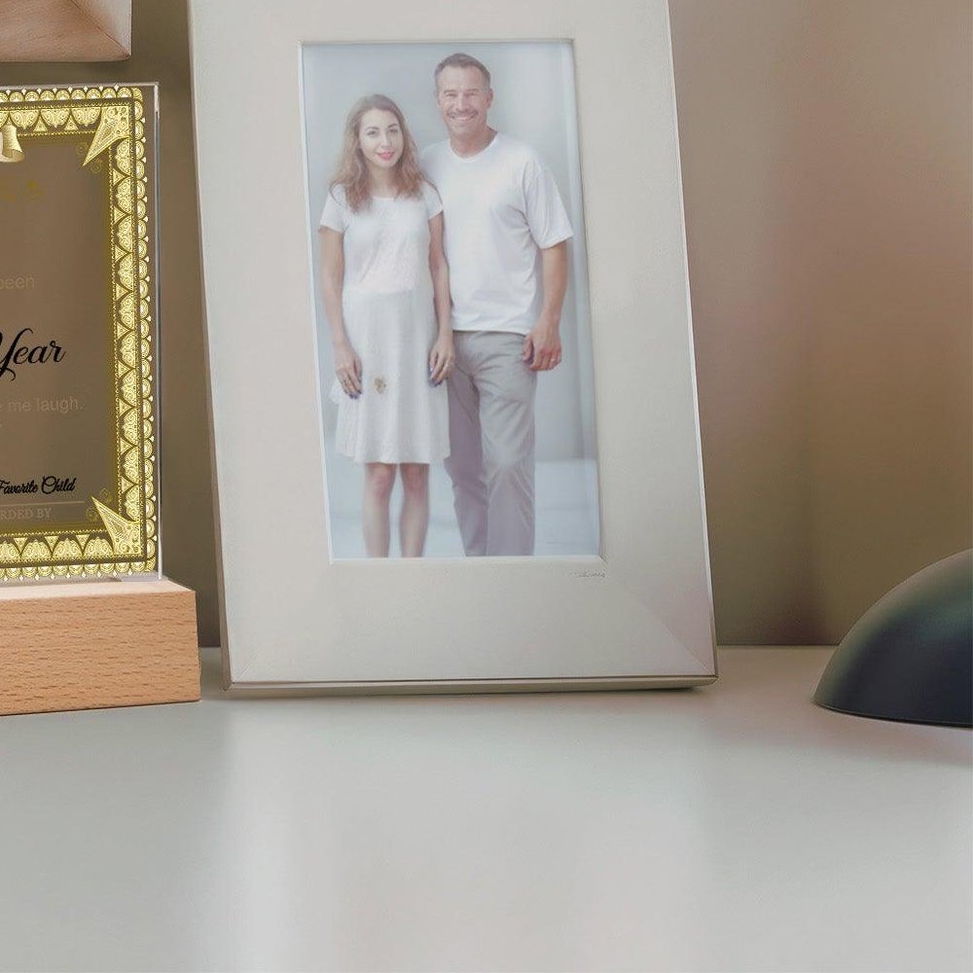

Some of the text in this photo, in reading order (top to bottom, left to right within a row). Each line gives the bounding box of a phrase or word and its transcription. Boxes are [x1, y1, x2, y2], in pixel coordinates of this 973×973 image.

[8, 400, 32, 412] me
[36, 395, 85, 414] laugh.
[40, 475, 77, 495] Child
[36, 507, 53, 520] BY
